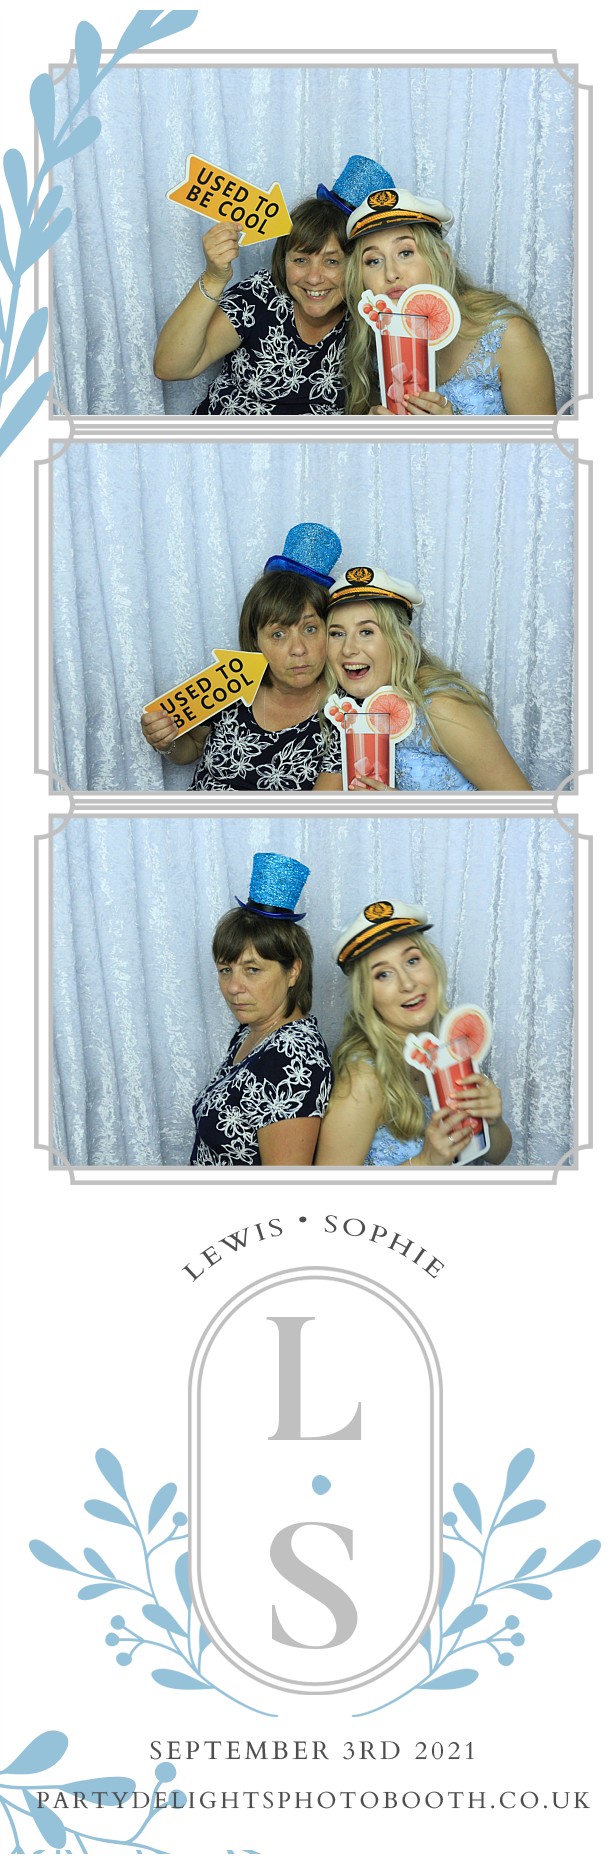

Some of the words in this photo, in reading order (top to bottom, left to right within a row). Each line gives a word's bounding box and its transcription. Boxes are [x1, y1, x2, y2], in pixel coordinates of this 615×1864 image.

[185, 184, 214, 209] BE
[218, 200, 268, 235] COOL
[196, 167, 249, 203] USED
[255, 195, 279, 218] TO
[160, 677, 212, 714] USED
[215, 657, 244, 680] TO
[172, 705, 197, 729] BE
[200, 673, 254, 710] COOL
